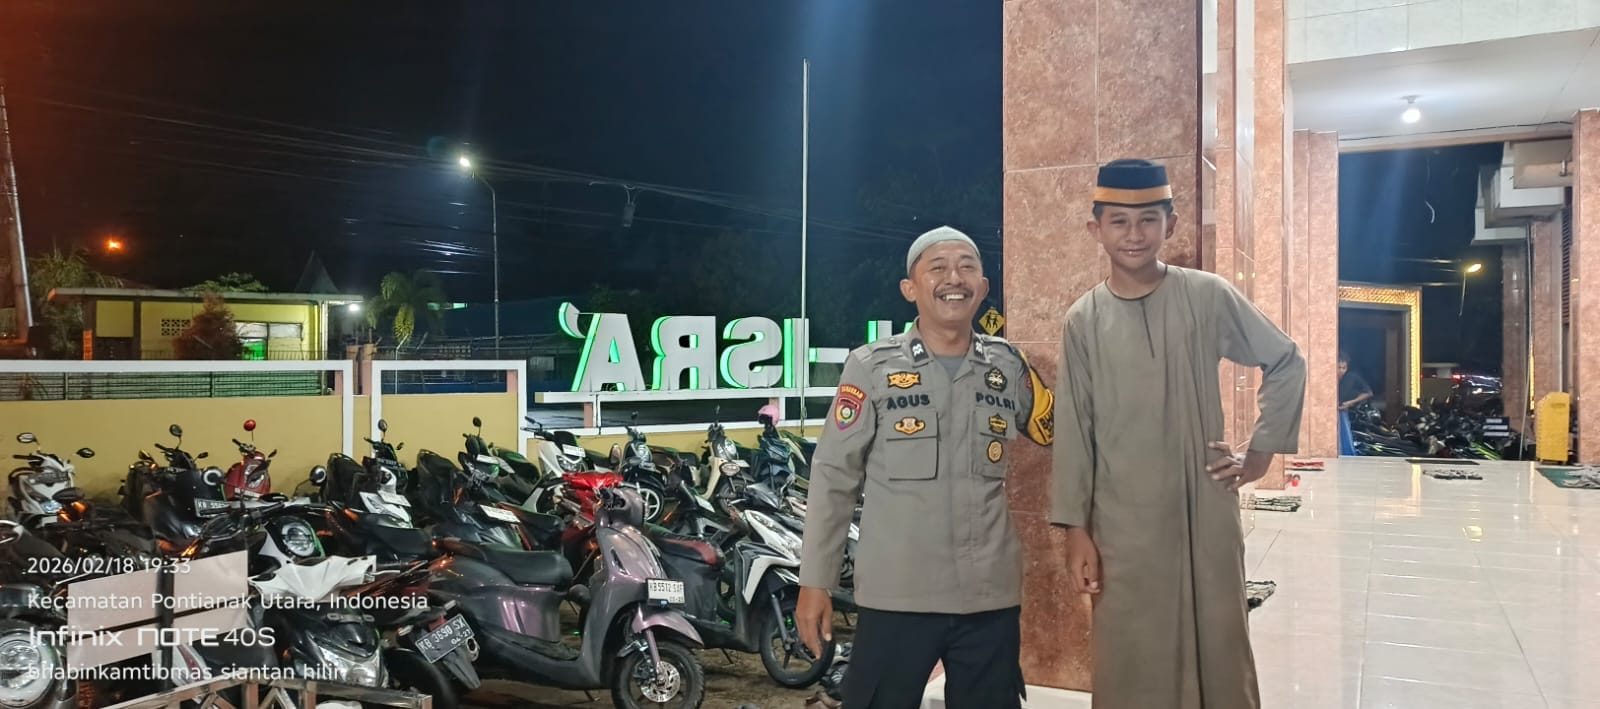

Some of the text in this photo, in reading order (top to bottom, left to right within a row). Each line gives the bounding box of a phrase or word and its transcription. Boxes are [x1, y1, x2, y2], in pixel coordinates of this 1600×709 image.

[887, 394, 930, 409] AGUS
[976, 392, 1016, 411] POLRI
[418, 617, 466, 650] KB 3690 SX
